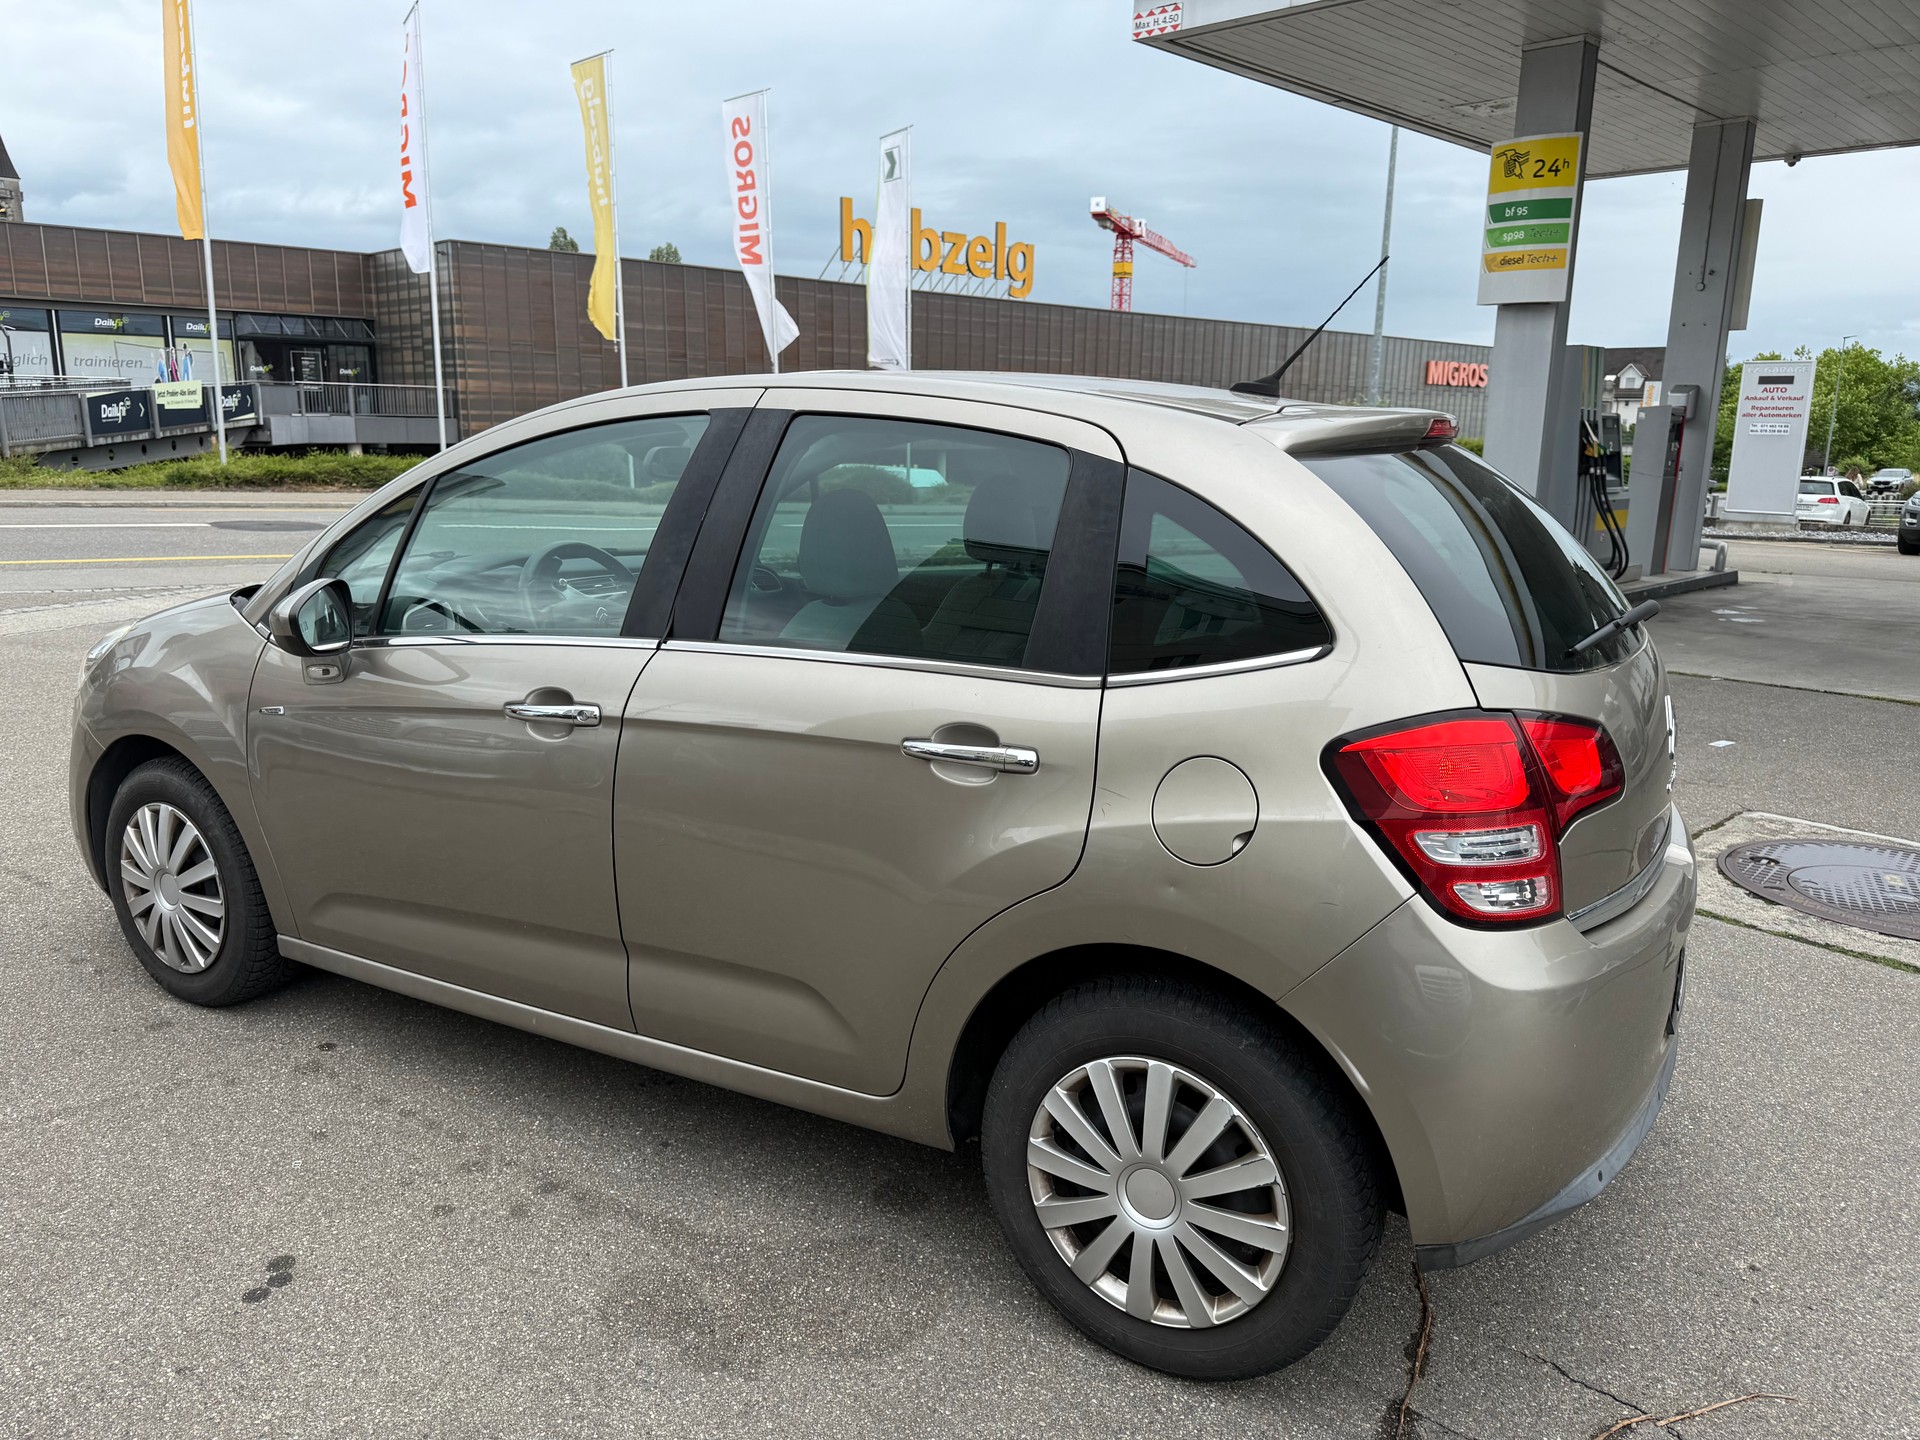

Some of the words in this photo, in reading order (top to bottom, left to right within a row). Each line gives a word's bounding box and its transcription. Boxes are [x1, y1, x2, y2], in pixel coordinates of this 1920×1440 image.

[1135, 21, 1151, 30] Max
[1504, 207, 1516, 217] bf
[1516, 206, 1529, 216] 95
[1502, 231, 1525, 242] sp98
[840, 196, 1035, 299] hbzelg
[1499, 254, 1525, 266] diesel
[1526, 253, 1558, 264] Tech+
[1426, 360, 1489, 388] MIGROS
